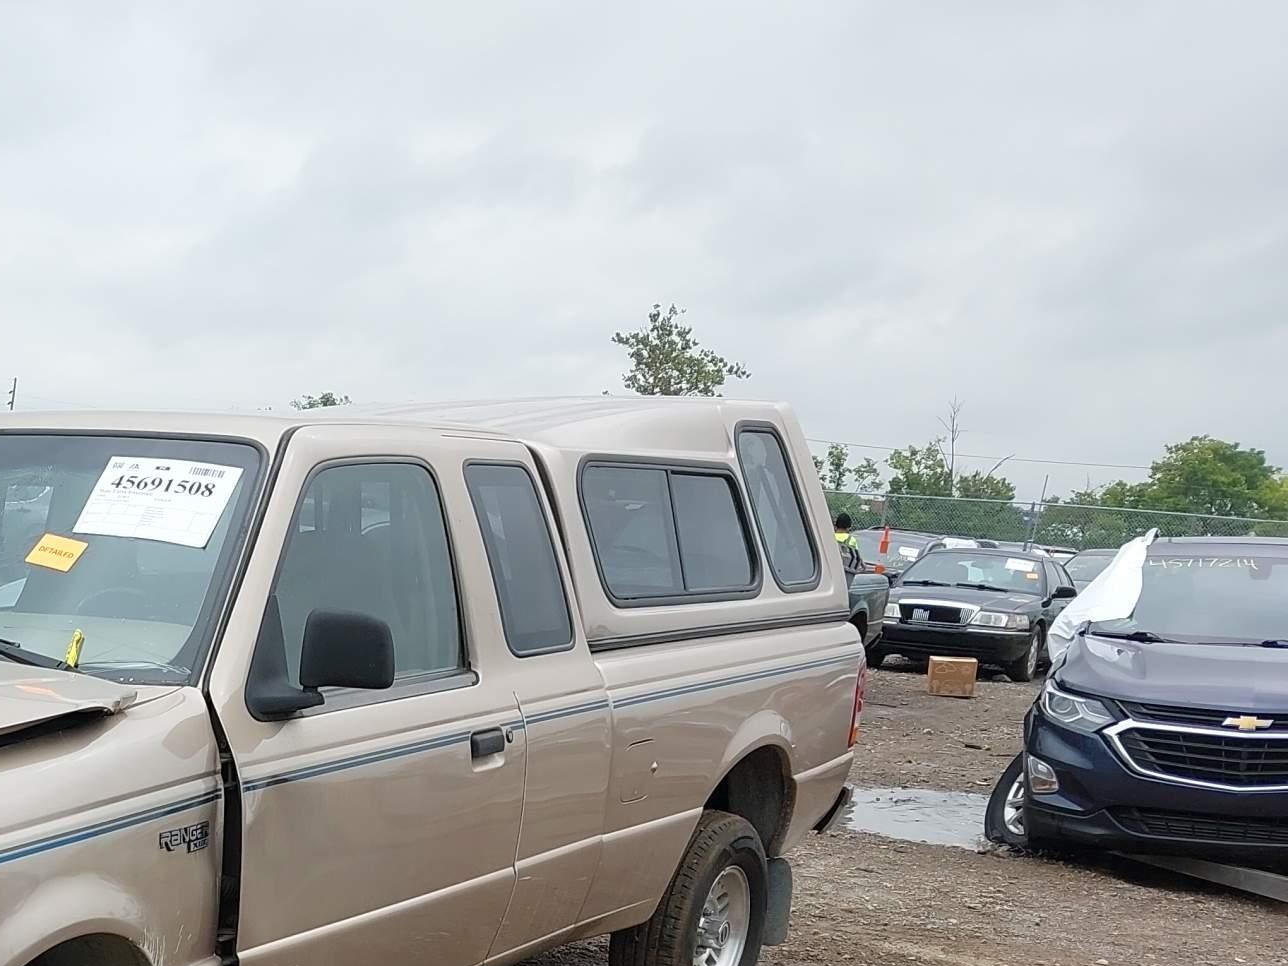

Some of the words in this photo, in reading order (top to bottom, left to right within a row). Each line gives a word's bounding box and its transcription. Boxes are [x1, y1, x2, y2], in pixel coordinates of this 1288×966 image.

[110, 474, 216, 498] 45691508
[38, 544, 74, 560] DETAILED
[1149, 558, 1259, 570] 45717214
